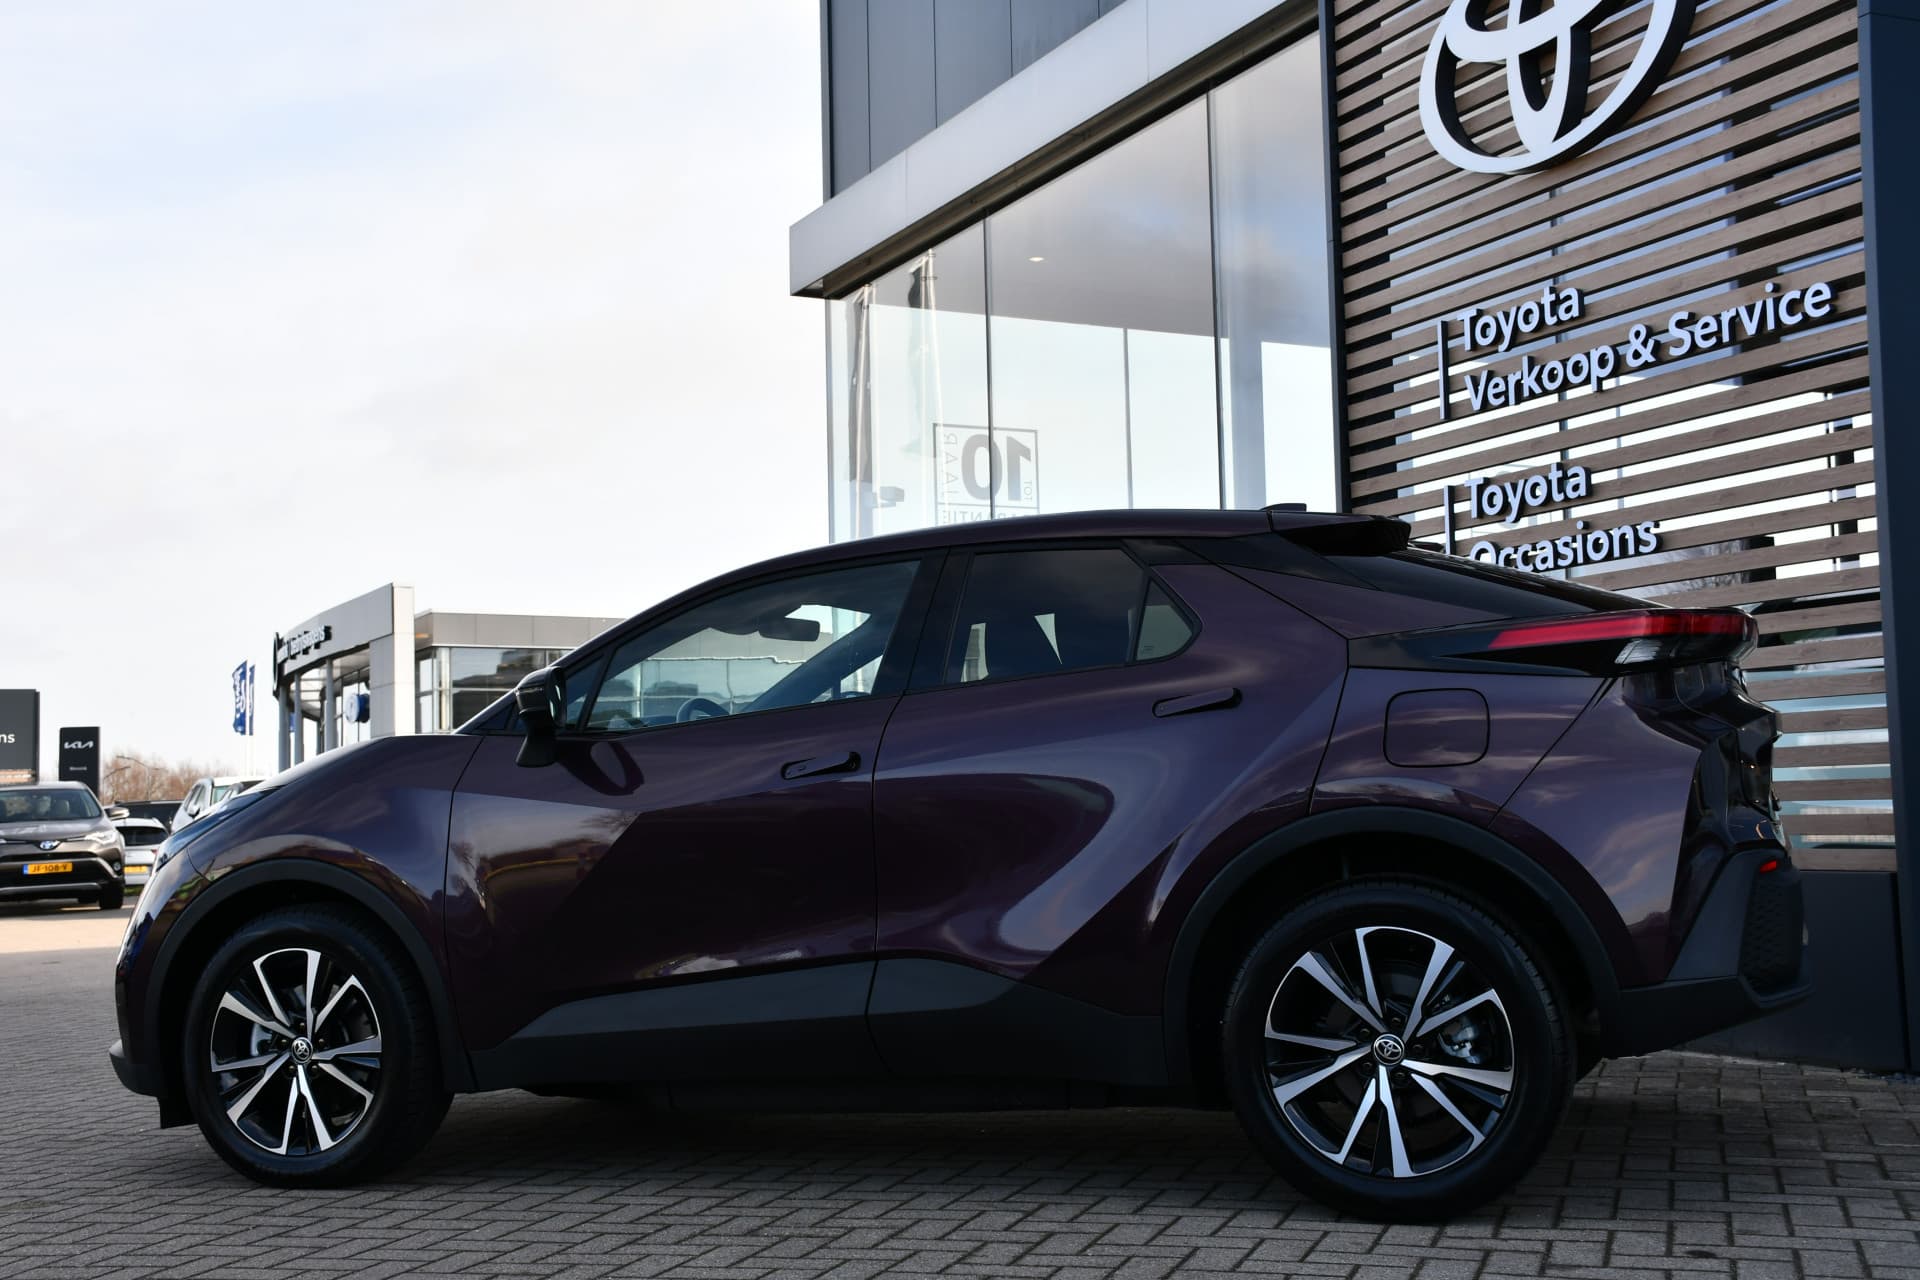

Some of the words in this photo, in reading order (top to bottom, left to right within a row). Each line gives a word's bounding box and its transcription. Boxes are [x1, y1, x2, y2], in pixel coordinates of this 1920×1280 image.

[1457, 285, 1582, 352] Toyota
[1465, 345, 1616, 412] Verkoop
[1626, 323, 1657, 368] &
[1668, 282, 1833, 357] Service
[1465, 463, 1589, 523] Toyota
